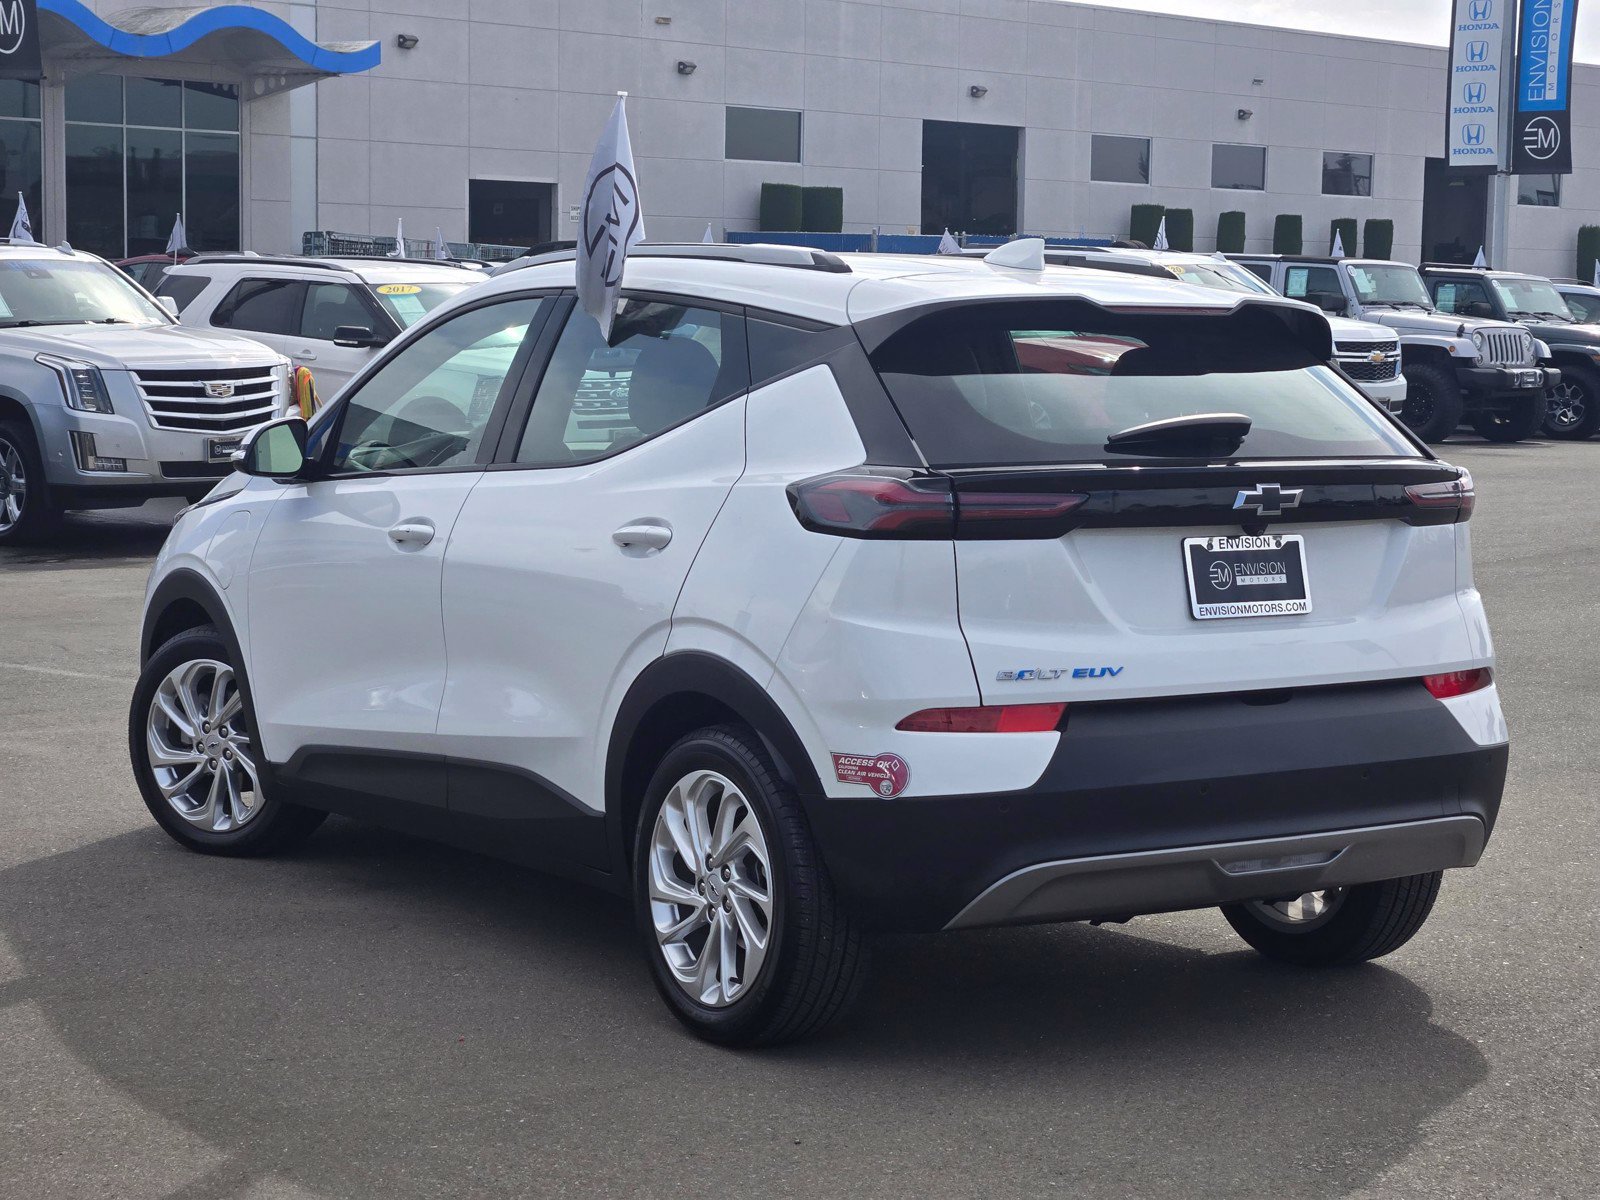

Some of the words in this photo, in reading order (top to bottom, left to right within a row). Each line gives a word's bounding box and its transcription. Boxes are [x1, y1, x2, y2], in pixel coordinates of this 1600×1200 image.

[1457, 23, 1500, 31] HONDA
[1528, 0, 1550, 101] ENVISION
[1548, 3, 1561, 91] MOTORS
[1455, 64, 1497, 73] HONDA
[1453, 106, 1495, 114] HONDA
[1452, 147, 1495, 155] HONDA
[1218, 537, 1271, 550] ENVISION
[1233, 561, 1286, 576] ENVISION
[1240, 576, 1284, 584] MOTORS
[1199, 602, 1307, 617] ENVISIONMOTORS.COM
[996, 667, 1068, 681] BOLT
[1072, 666, 1124, 679] EUV
[838, 757, 874, 767] ACCESS
[877, 760, 892, 768] OK
